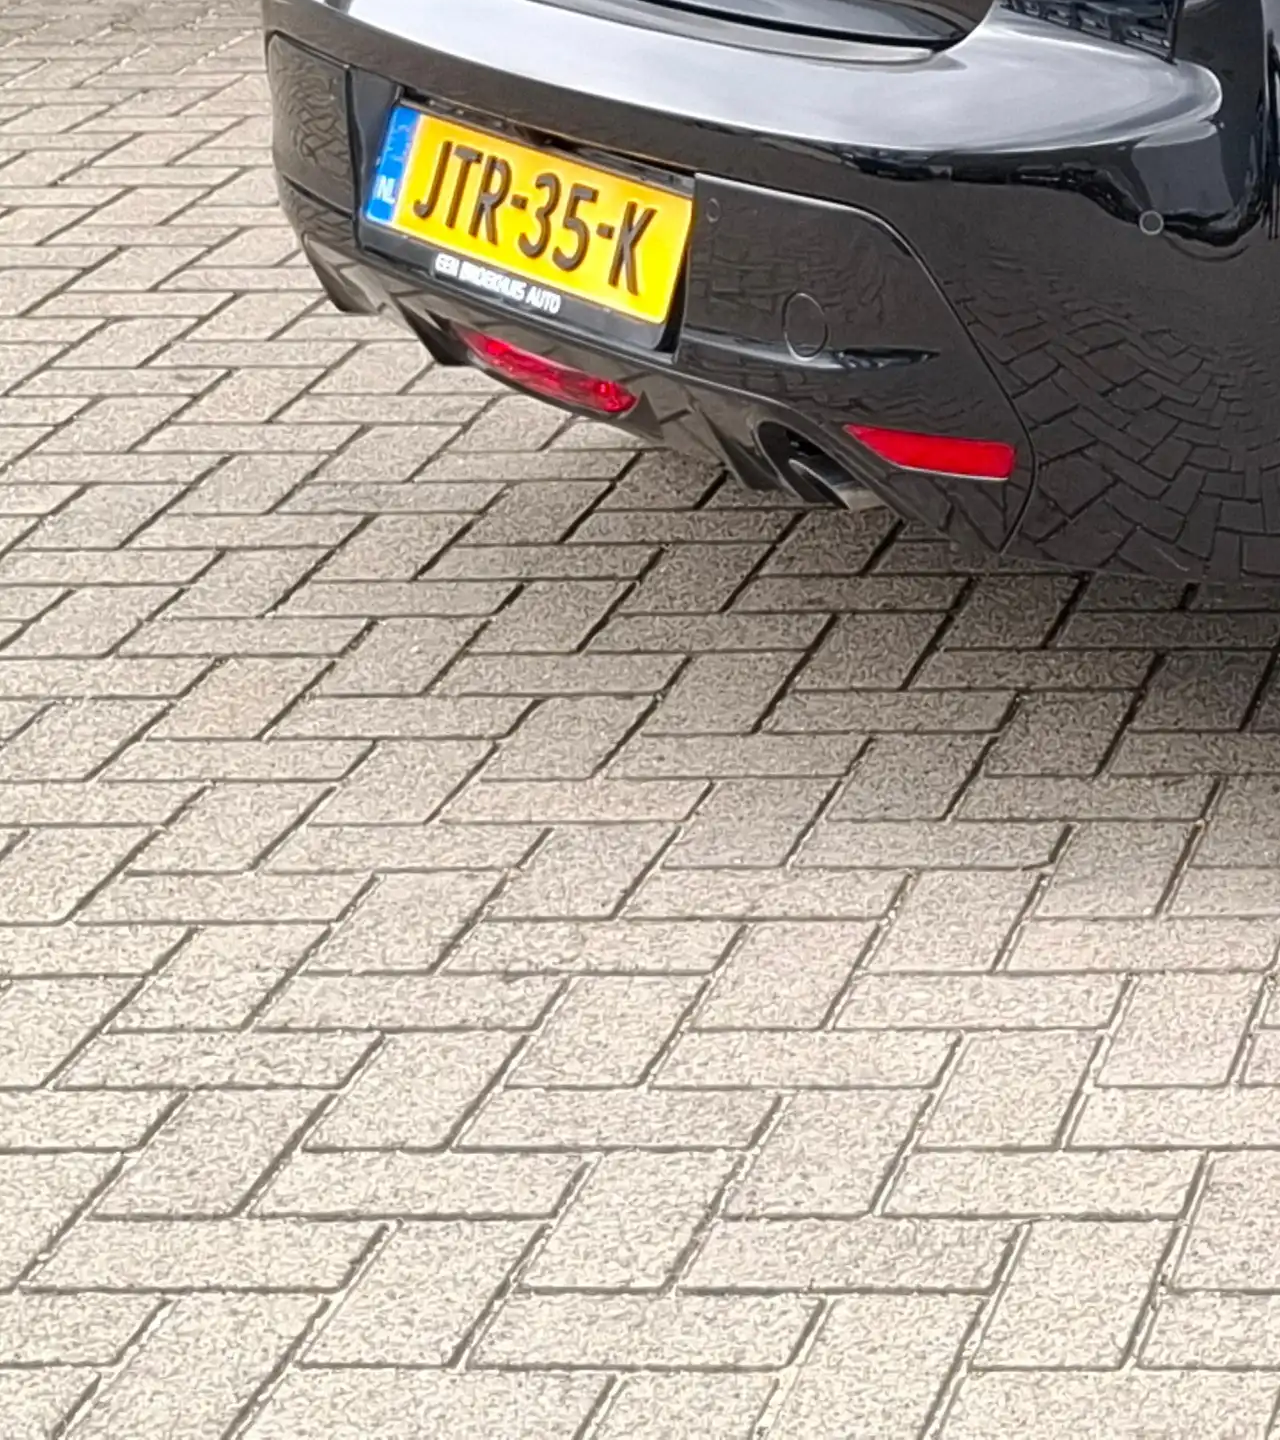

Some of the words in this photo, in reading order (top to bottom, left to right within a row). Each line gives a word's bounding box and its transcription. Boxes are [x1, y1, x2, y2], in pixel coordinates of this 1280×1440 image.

[376, 174, 397, 205] NL
[413, 140, 658, 296] JTR-35-K
[525, 285, 562, 315] AUTO
